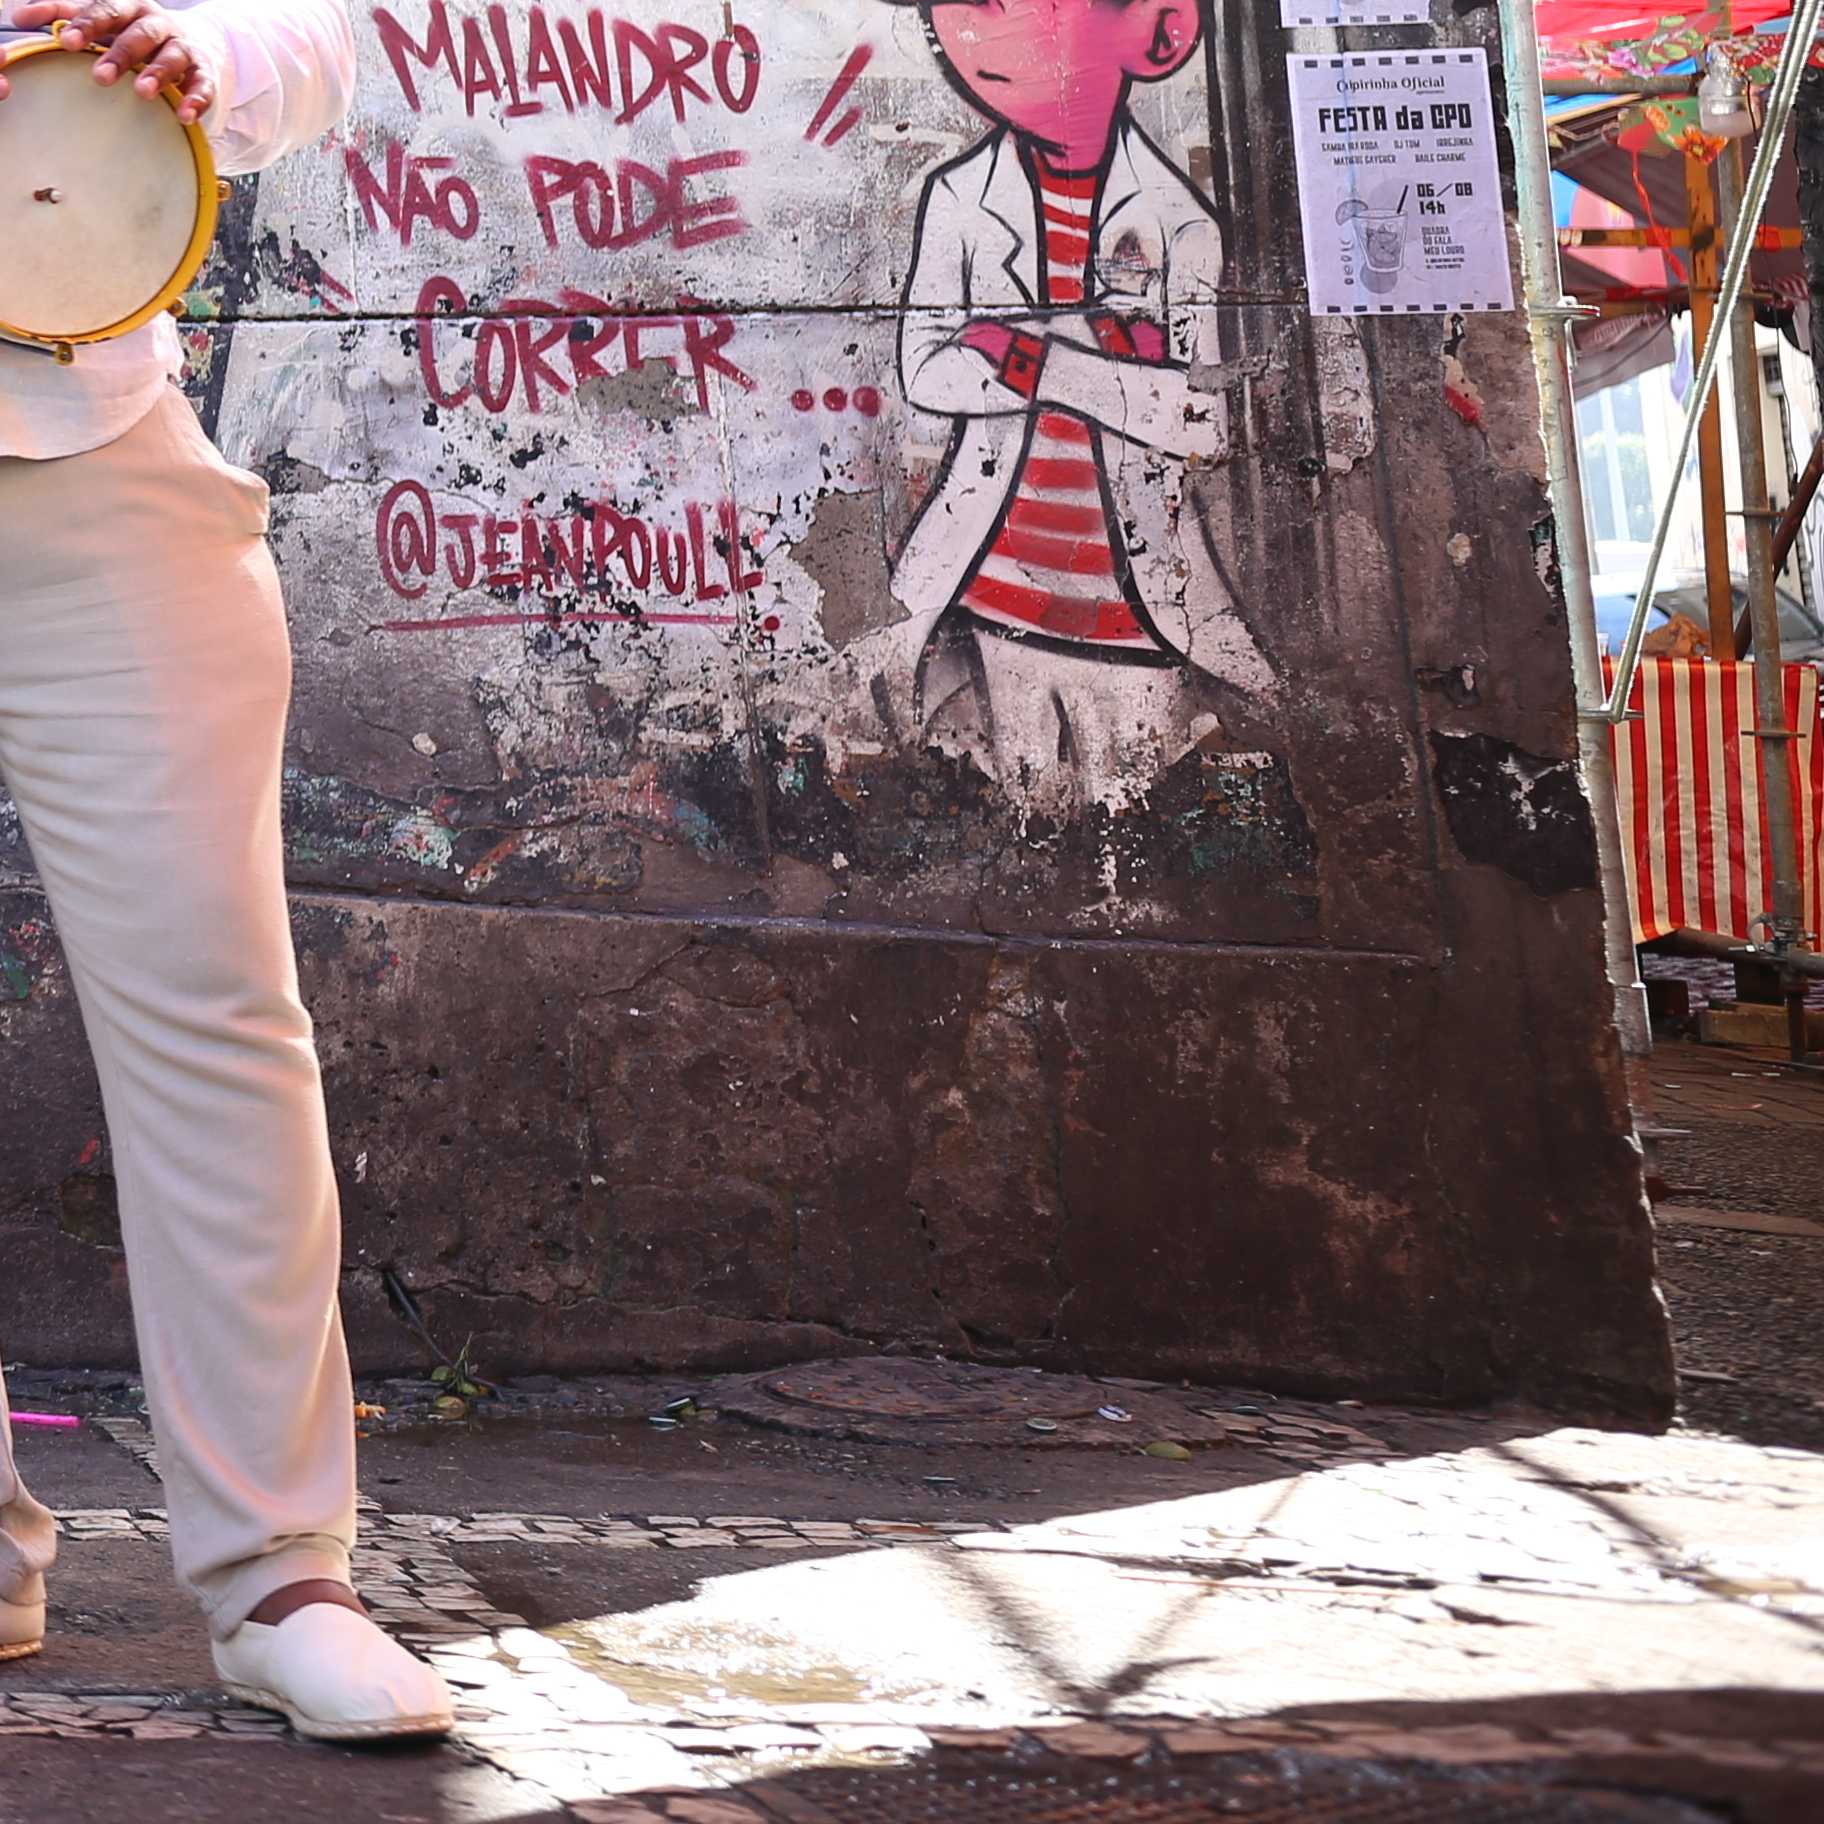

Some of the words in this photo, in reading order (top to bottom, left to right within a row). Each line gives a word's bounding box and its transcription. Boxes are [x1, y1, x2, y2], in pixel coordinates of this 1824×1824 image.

[1318, 106, 1387, 133] FESTA
[1395, 105, 1424, 130] da
[1430, 104, 1473, 129] CPO
[344, 139, 479, 247] NÃO
[525, 149, 749, 249] PODE
[1419, 201, 1446, 215] 14h
[376, 479, 763, 601] @JEANPOULL
